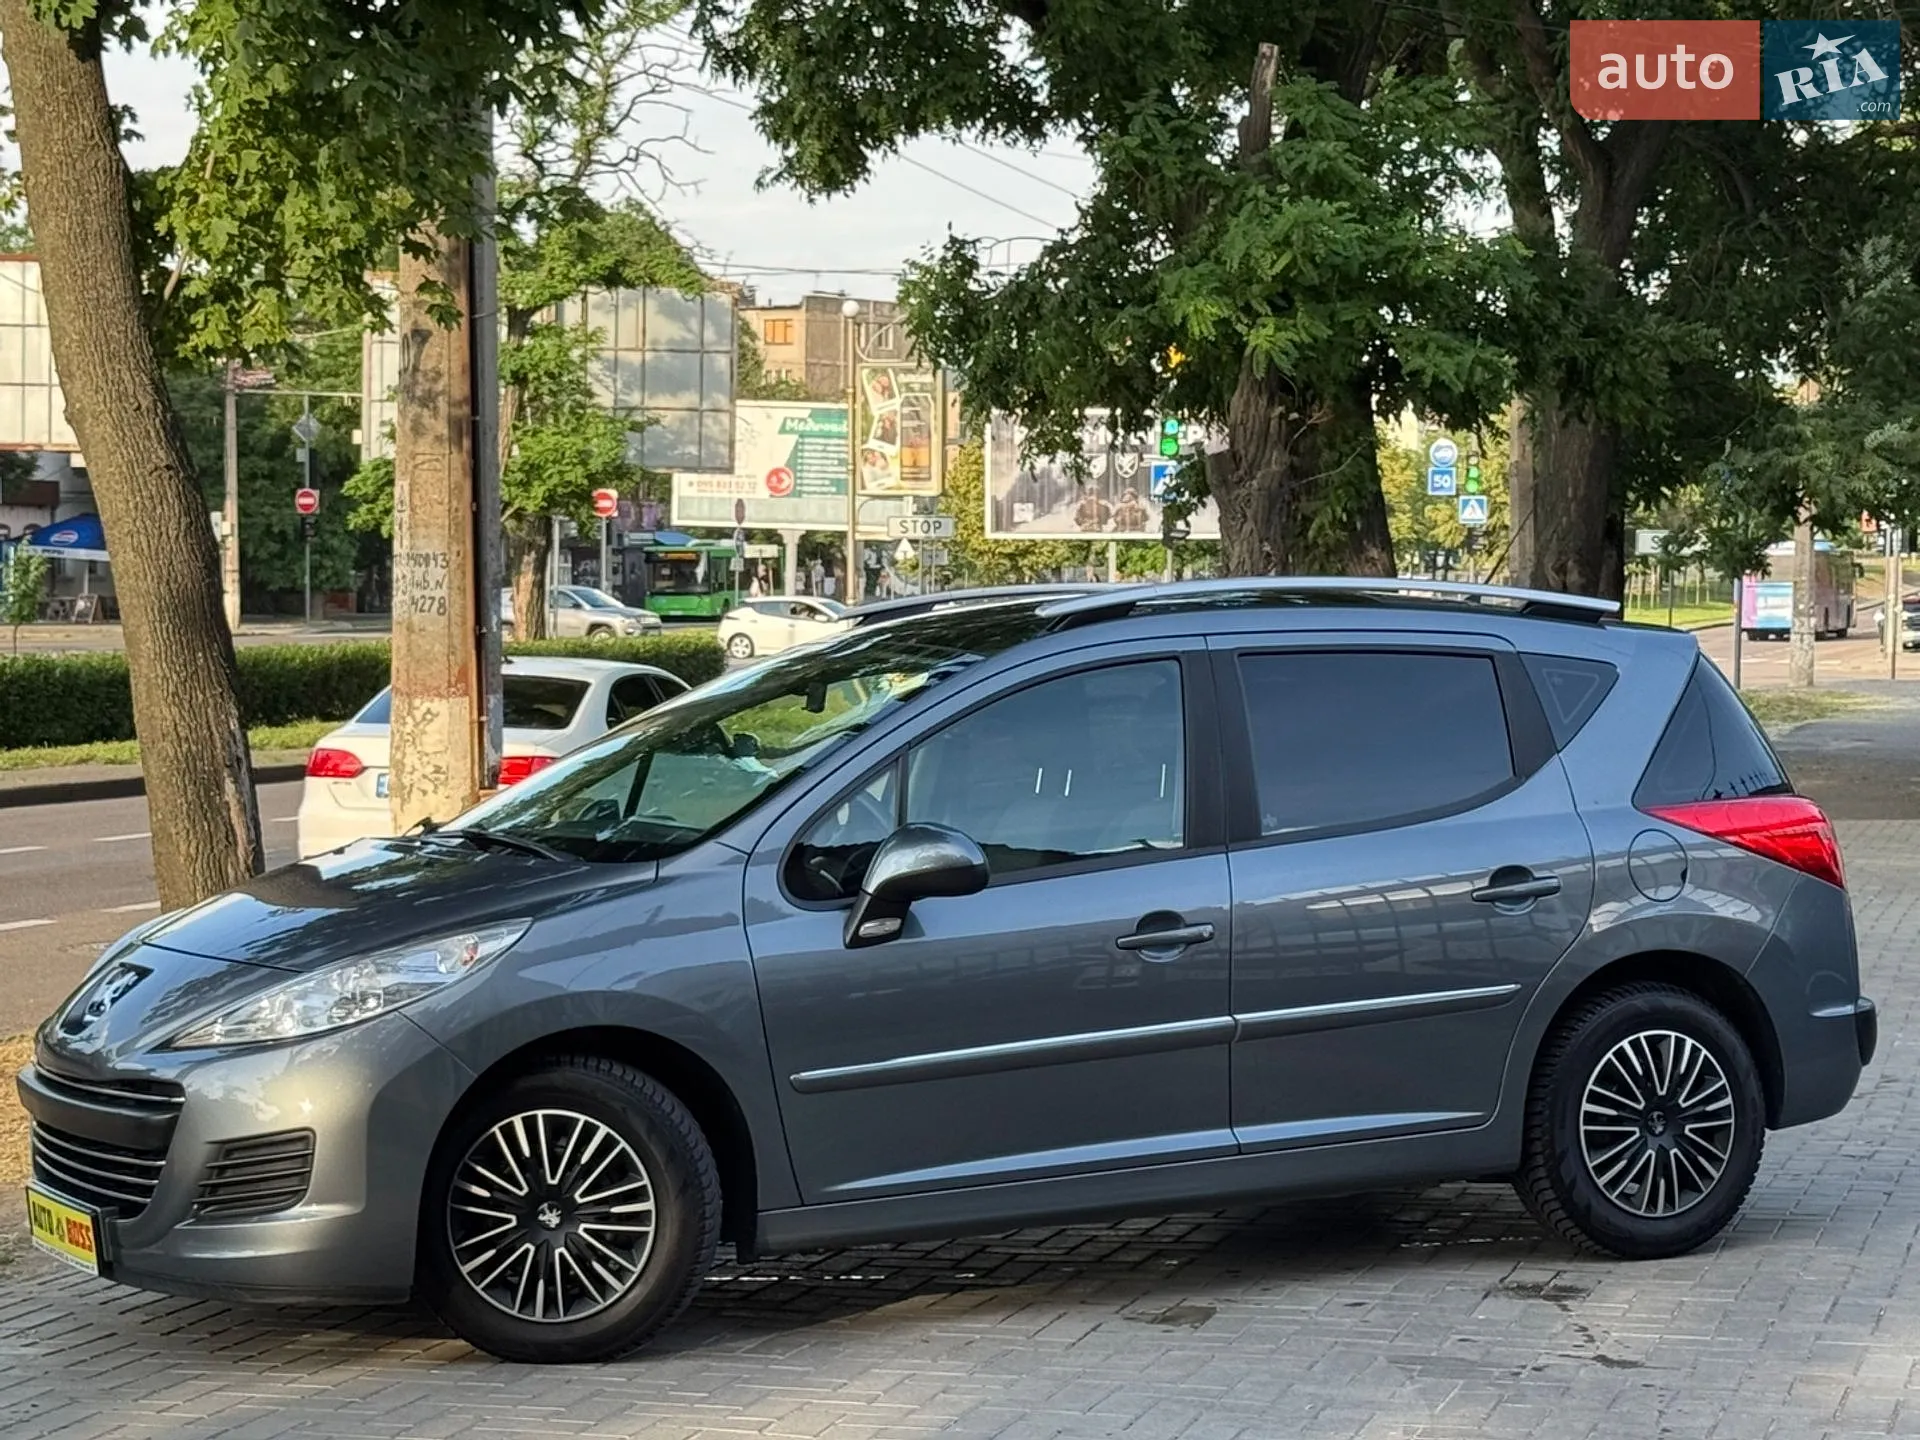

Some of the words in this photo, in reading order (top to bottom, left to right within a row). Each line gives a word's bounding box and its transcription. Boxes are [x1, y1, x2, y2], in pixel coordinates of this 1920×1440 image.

[1433, 474, 1451, 488] 50
[899, 519, 943, 535] STOP
[32, 1201, 54, 1235] AUTO
